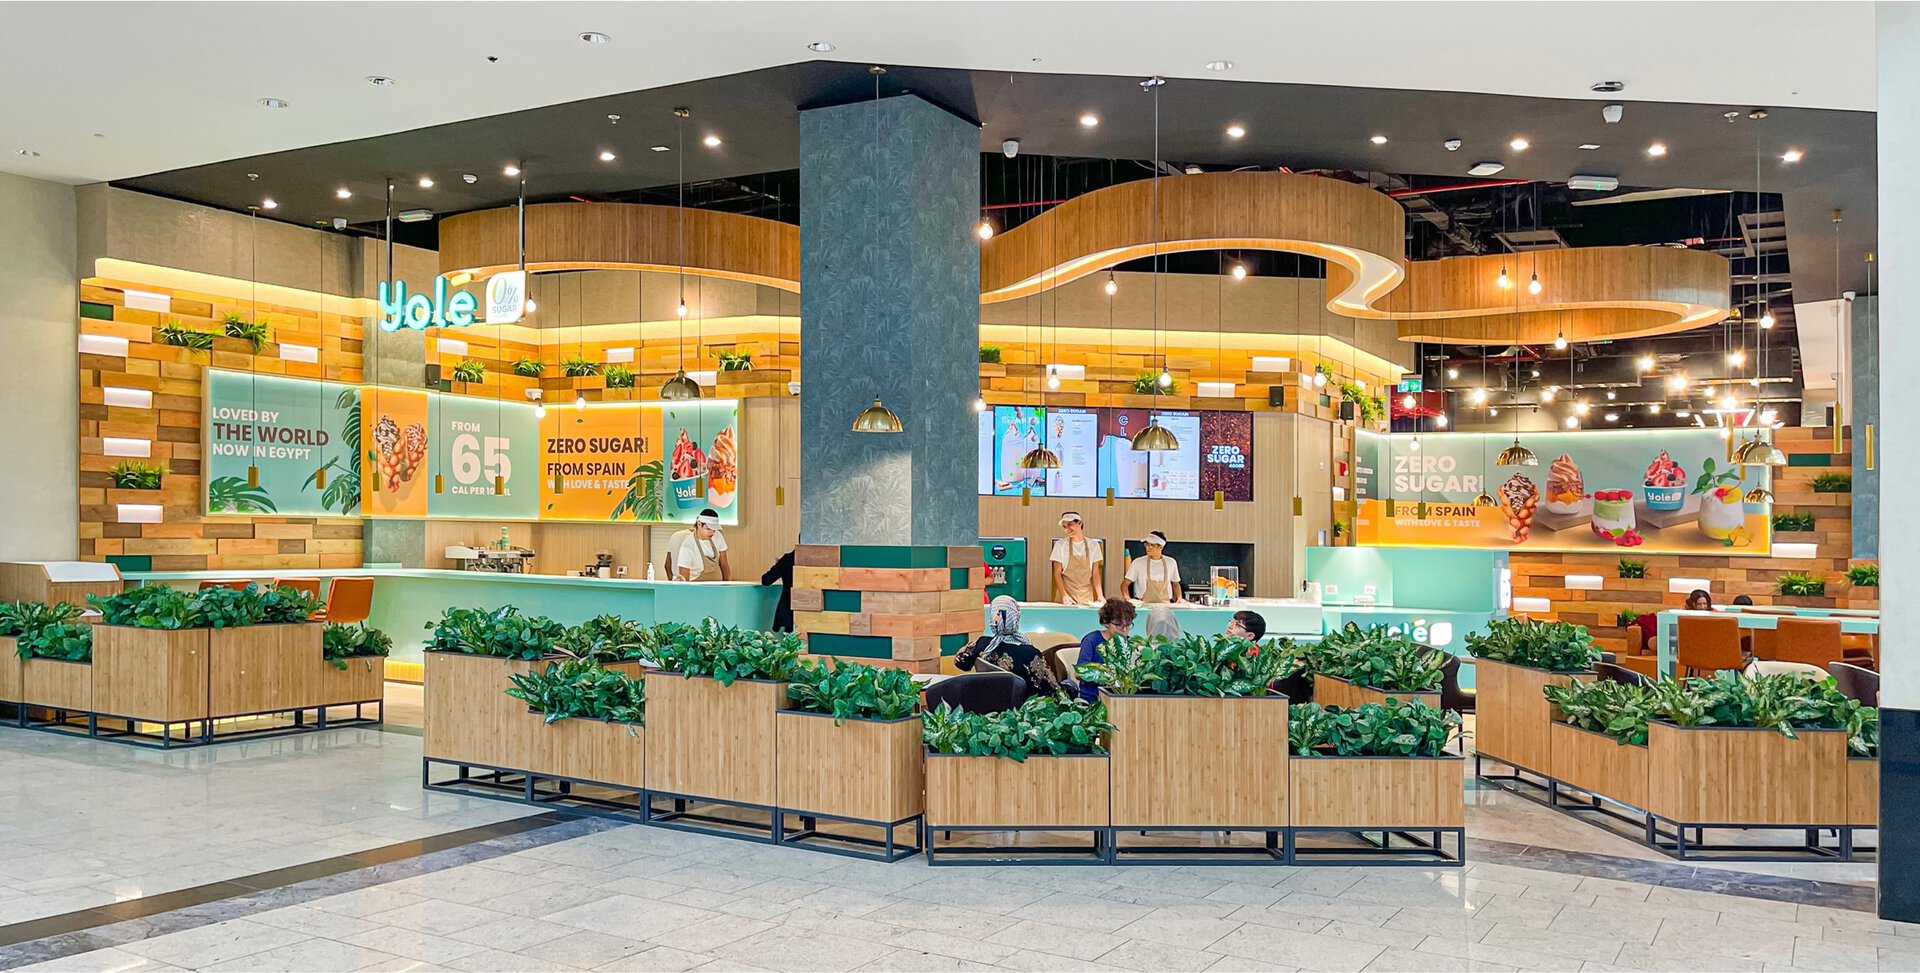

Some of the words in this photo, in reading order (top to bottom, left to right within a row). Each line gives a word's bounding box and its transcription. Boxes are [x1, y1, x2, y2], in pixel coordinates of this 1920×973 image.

[492, 277, 519, 305] 0%
[492, 304, 518, 314] SUGAR
[212, 407, 258, 422] LOVED
[261, 411, 279, 423] BY
[213, 422, 252, 442] THE
[257, 426, 329, 446] WORLD
[451, 421, 480, 433] FROM
[212, 443, 249, 457] NOW
[253, 446, 266, 458] IN
[269, 446, 311, 460] EGYPT
[547, 438, 586, 454] ZERO
[589, 437, 644, 454] SUGAR
[1211, 445, 1240, 455] ZERO
[451, 433, 512, 486] 65
[1207, 454, 1245, 463] SUGAR
[1394, 455, 1457, 473] ZERO
[547, 462, 584, 476] FROM
[586, 462, 625, 476] SPAIN
[451, 486, 469, 495] CAL
[470, 487, 486, 495] PER
[547, 479, 569, 489] WH
[571, 479, 592, 489] LOVE
[594, 480, 601, 489] &
[1394, 474, 1478, 493] SUGAR
[1395, 506, 1432, 516] FROM
[1435, 506, 1476, 516] SPAIN
[1453, 519, 1480, 528] TASTE
